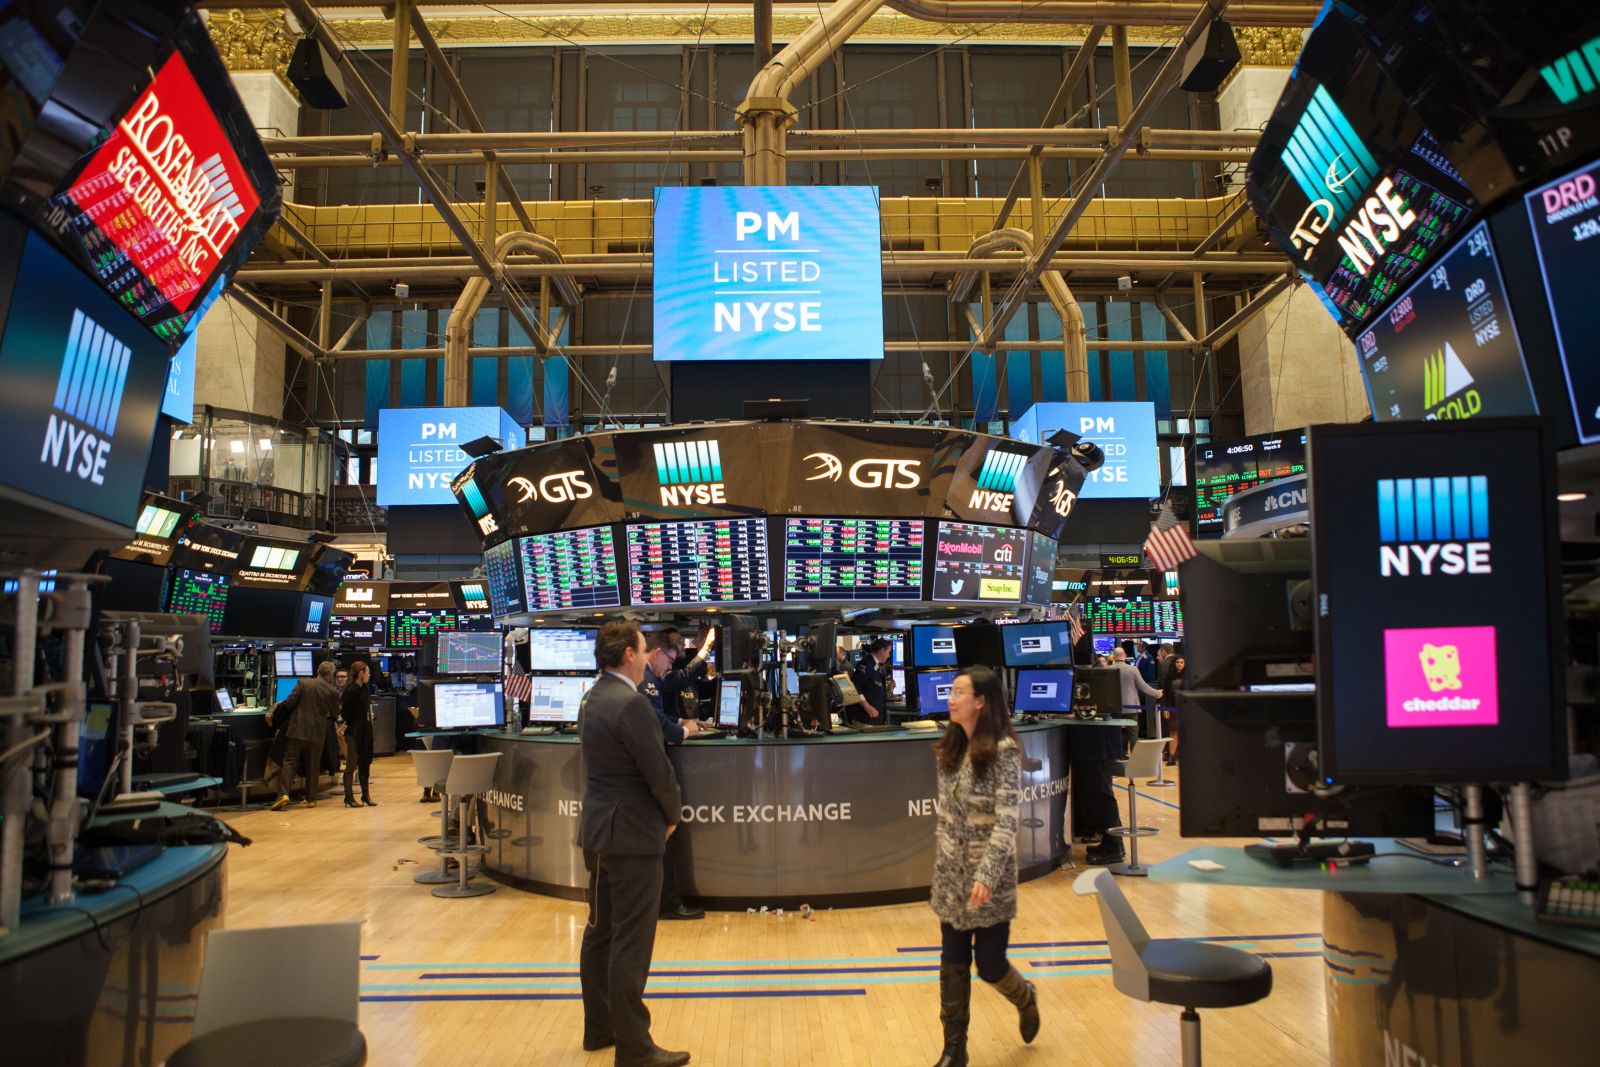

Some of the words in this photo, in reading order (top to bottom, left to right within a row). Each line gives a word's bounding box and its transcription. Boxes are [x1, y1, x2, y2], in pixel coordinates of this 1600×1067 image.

[127, 91, 240, 253] ROSENBLATT
[108, 146, 188, 245] SECURITIES
[1543, 174, 1596, 214] DRD
[736, 211, 799, 241] PM
[1337, 176, 1417, 276] NYSE
[714, 261, 821, 283] LISTED
[1465, 279, 1486, 302] DRD
[714, 302, 822, 332] NYSE
[1475, 320, 1500, 347] NYSE
[421, 423, 457, 439] PM
[1080, 417, 1115, 433] PM
[41, 413, 112, 486] NYSE
[409, 450, 467, 463] LISTED
[848, 458, 922, 489] GTS
[1090, 466, 1129, 482] YSE
[1291, 464, 1305, 473] SPX
[408, 473, 458, 490] NYS
[539, 470, 593, 503] GTS
[659, 483, 727, 507] NYSE
[968, 489, 1015, 513] NYSE
[938, 540, 983, 556] ExxonMobil
[994, 545, 1013, 562] citi
[1108, 556, 1138, 564] 4:06:50
[1380, 542, 1492, 577] NYSE
[987, 583, 1000, 594] Snap
[1068, 581, 1087, 590] imc
[1166, 587, 1180, 596] NY
[465, 600, 489, 609] NYSE
[305, 622, 321, 633] NYSE
[995, 617, 1020, 625] nielsen
[1403, 696, 1481, 713] cheddar
[681, 805, 726, 823] OCK
[733, 802, 852, 823] EXCHANGE
